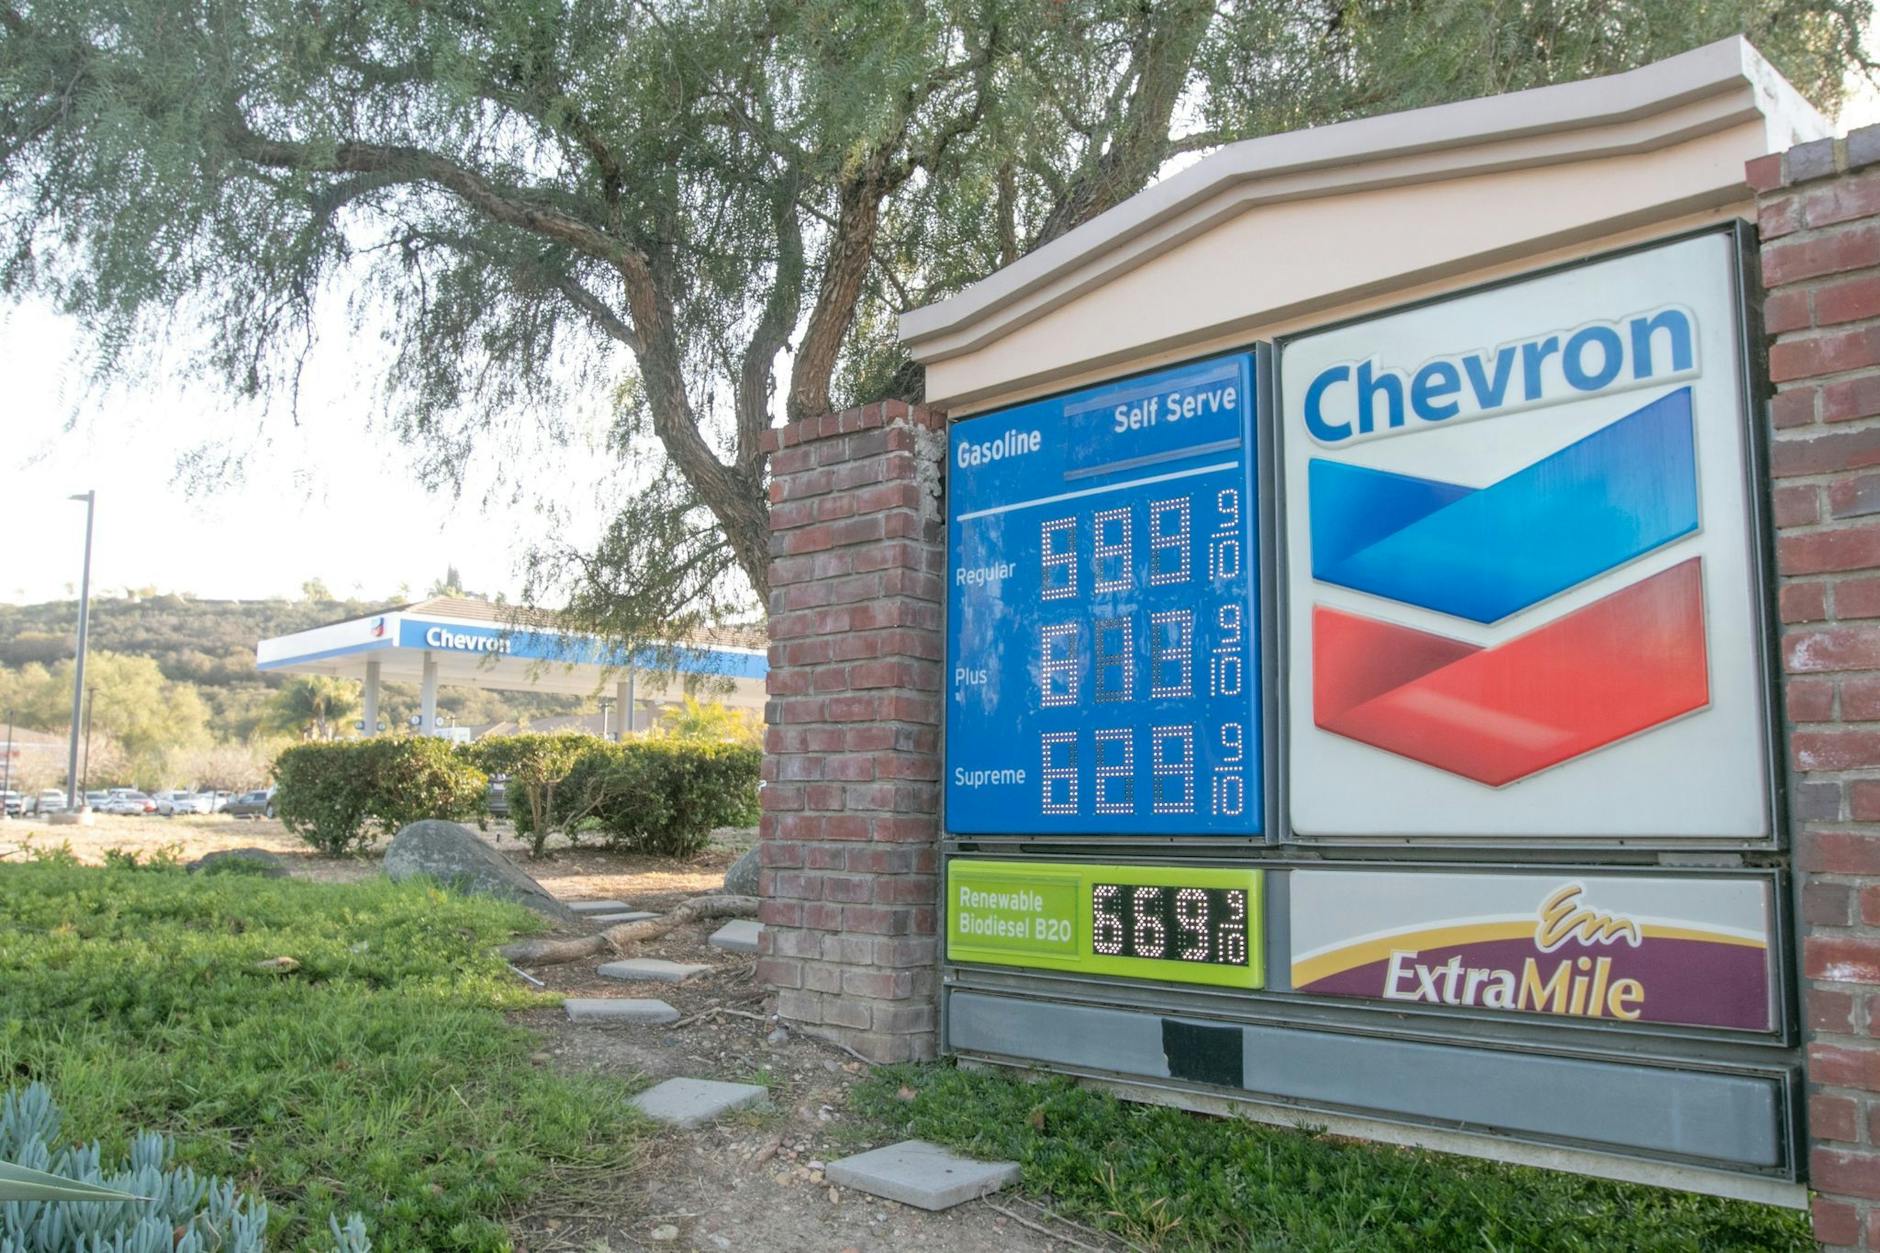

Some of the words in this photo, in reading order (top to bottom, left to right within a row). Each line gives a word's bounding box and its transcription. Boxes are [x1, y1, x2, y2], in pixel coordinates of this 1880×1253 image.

[1304, 309, 1693, 443] Chevron
[1113, 399, 1158, 434] Self
[1166, 386, 1237, 422] Serve
[957, 429, 1041, 469] Gasoline
[956, 561, 1016, 587] Regular
[426, 626, 511, 654] Chevron
[955, 667, 987, 687] Plus
[955, 767, 1026, 789] Supreme
[959, 885, 1043, 913] Renewable
[959, 912, 1030, 940] Biodiesel
[1035, 919, 1072, 943] B20
[1383, 947, 1646, 1022] ExtraMile
